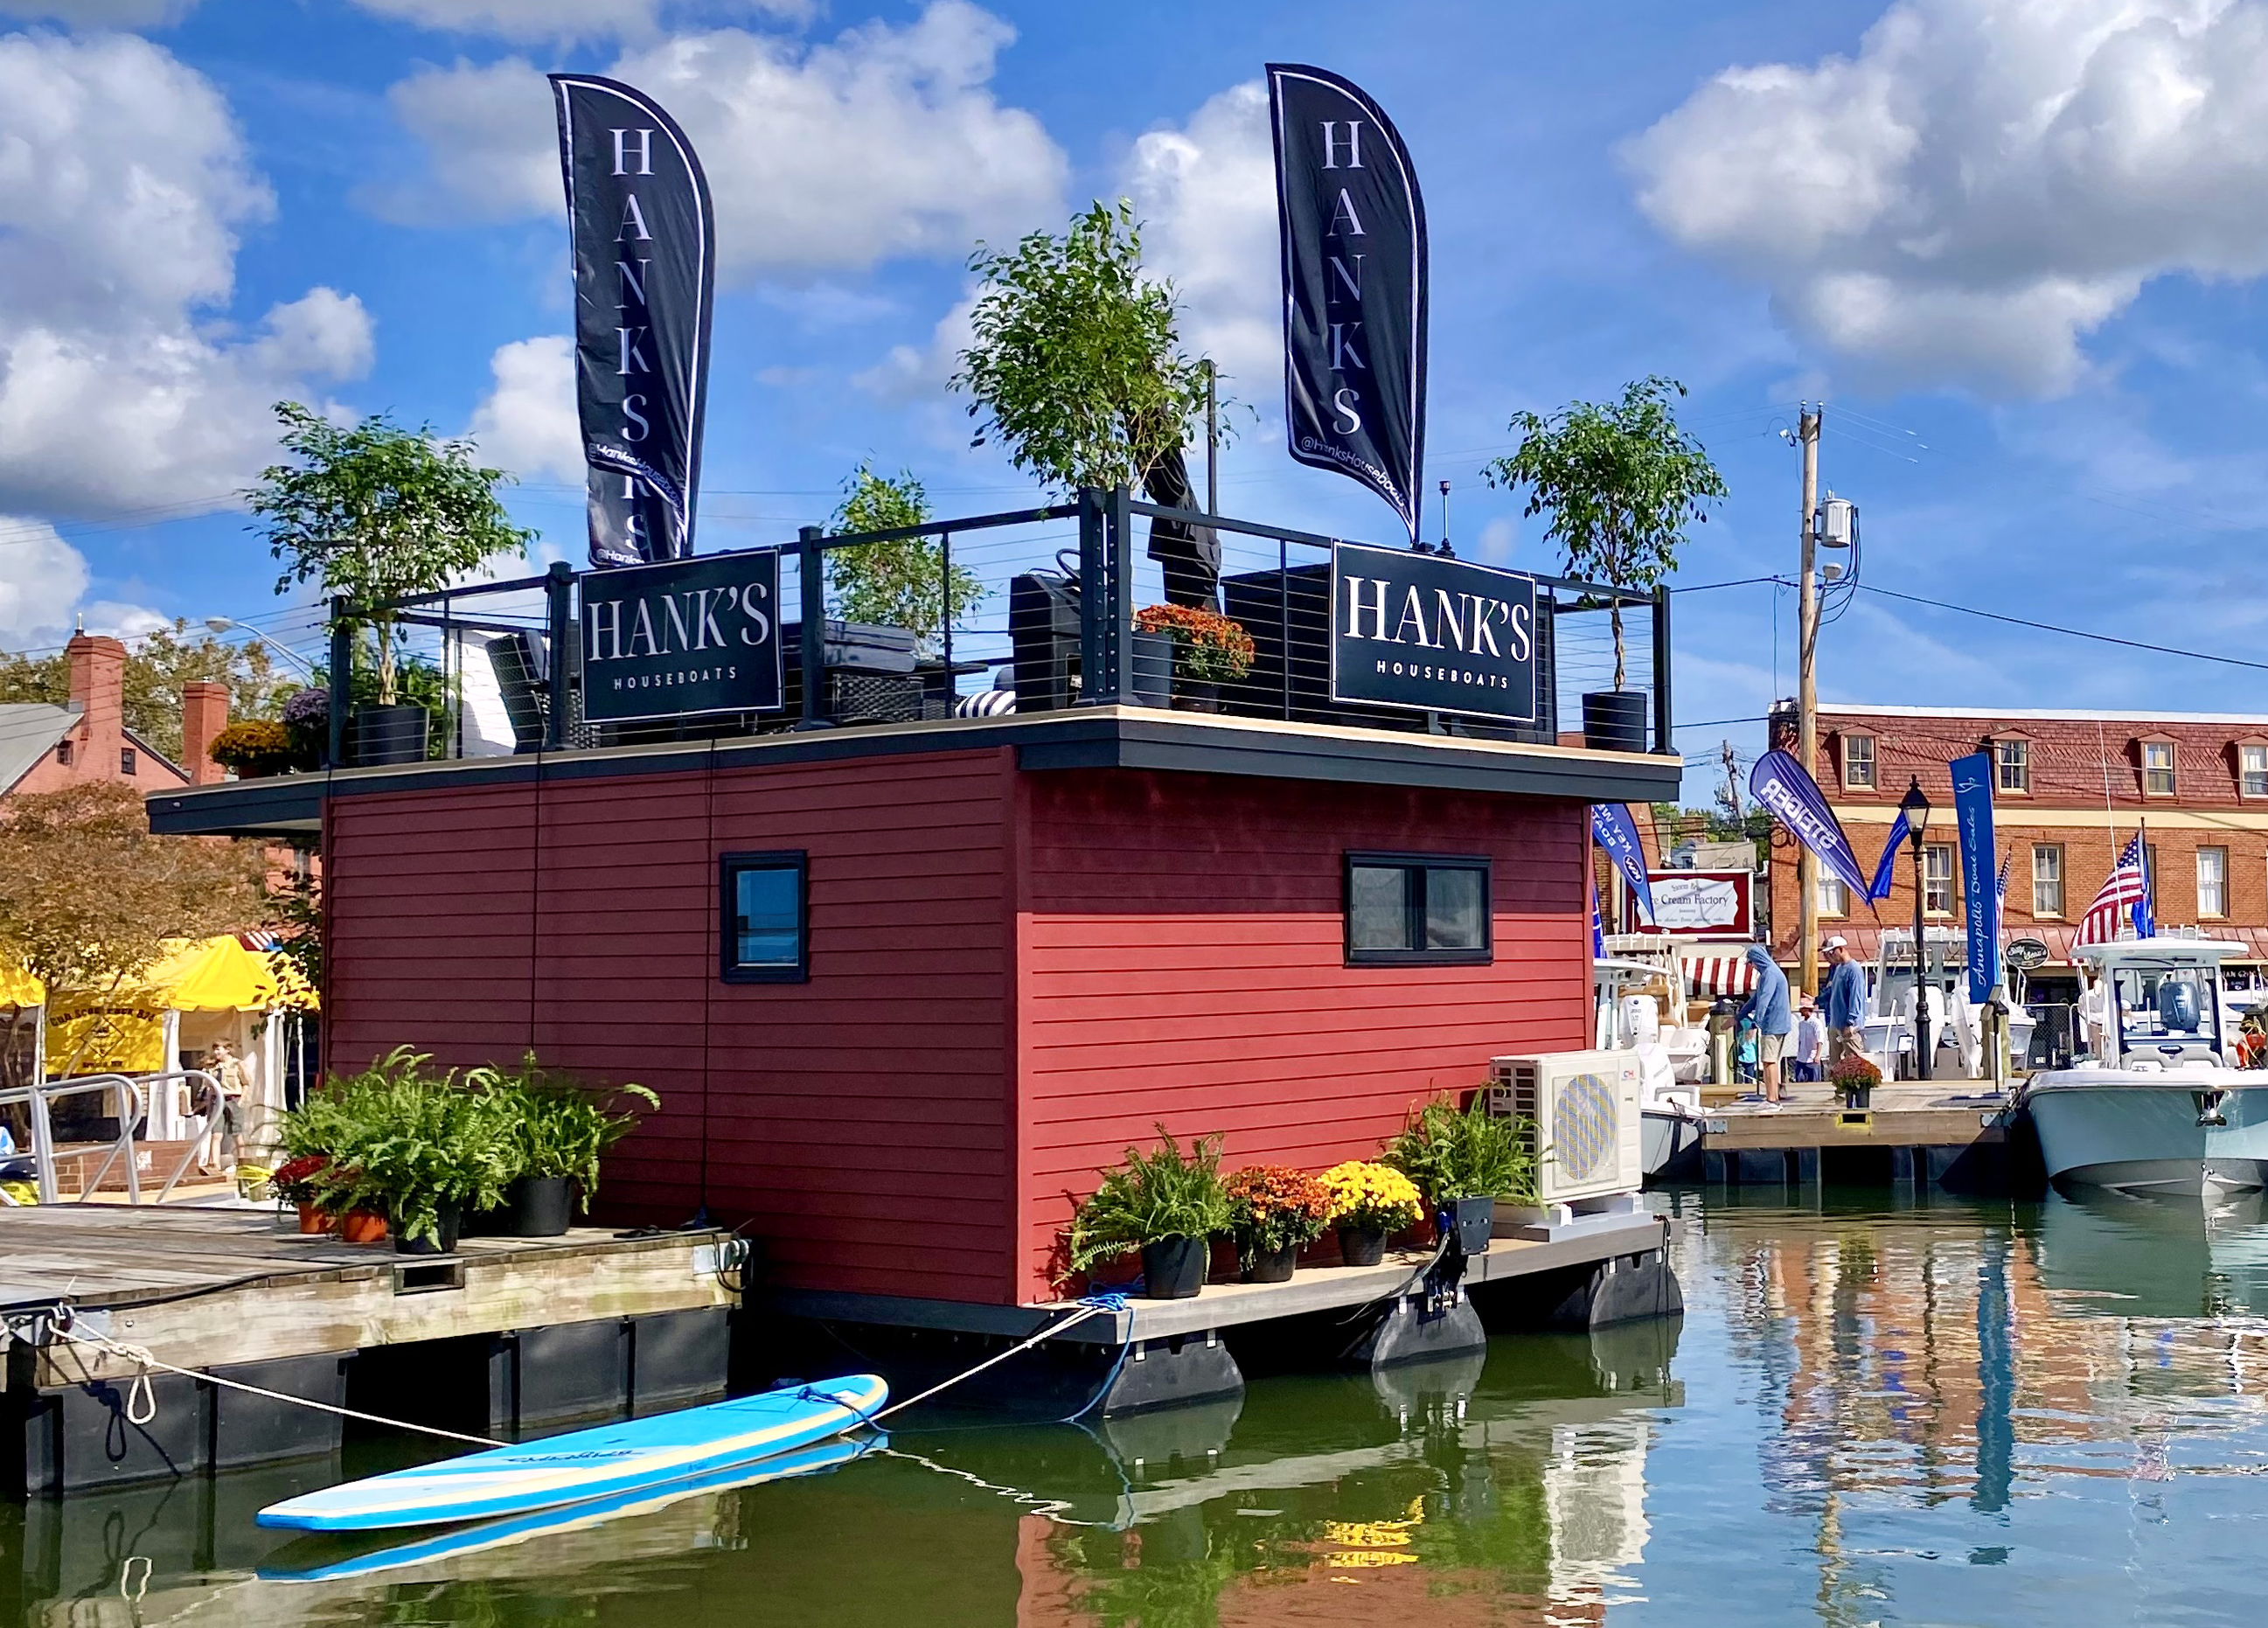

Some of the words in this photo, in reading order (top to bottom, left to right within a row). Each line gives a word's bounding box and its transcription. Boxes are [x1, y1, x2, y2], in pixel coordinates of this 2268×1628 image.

[609, 128, 655, 442] HANKS
[1319, 121, 1366, 435] HANKS
[588, 582, 769, 662] HANK'S
[1343, 575, 1530, 662] HANK'S
[614, 666, 737, 690] HOUSEBOATS
[1376, 660, 1509, 689] HOUSEBOATS
[1966, 806, 1978, 853] Sales
[1661, 894, 1691, 905] Cream
[1694, 894, 1729, 907] Factory
[1971, 900, 1989, 988] Annapolis
[74, 1007, 104, 1018] Scou
